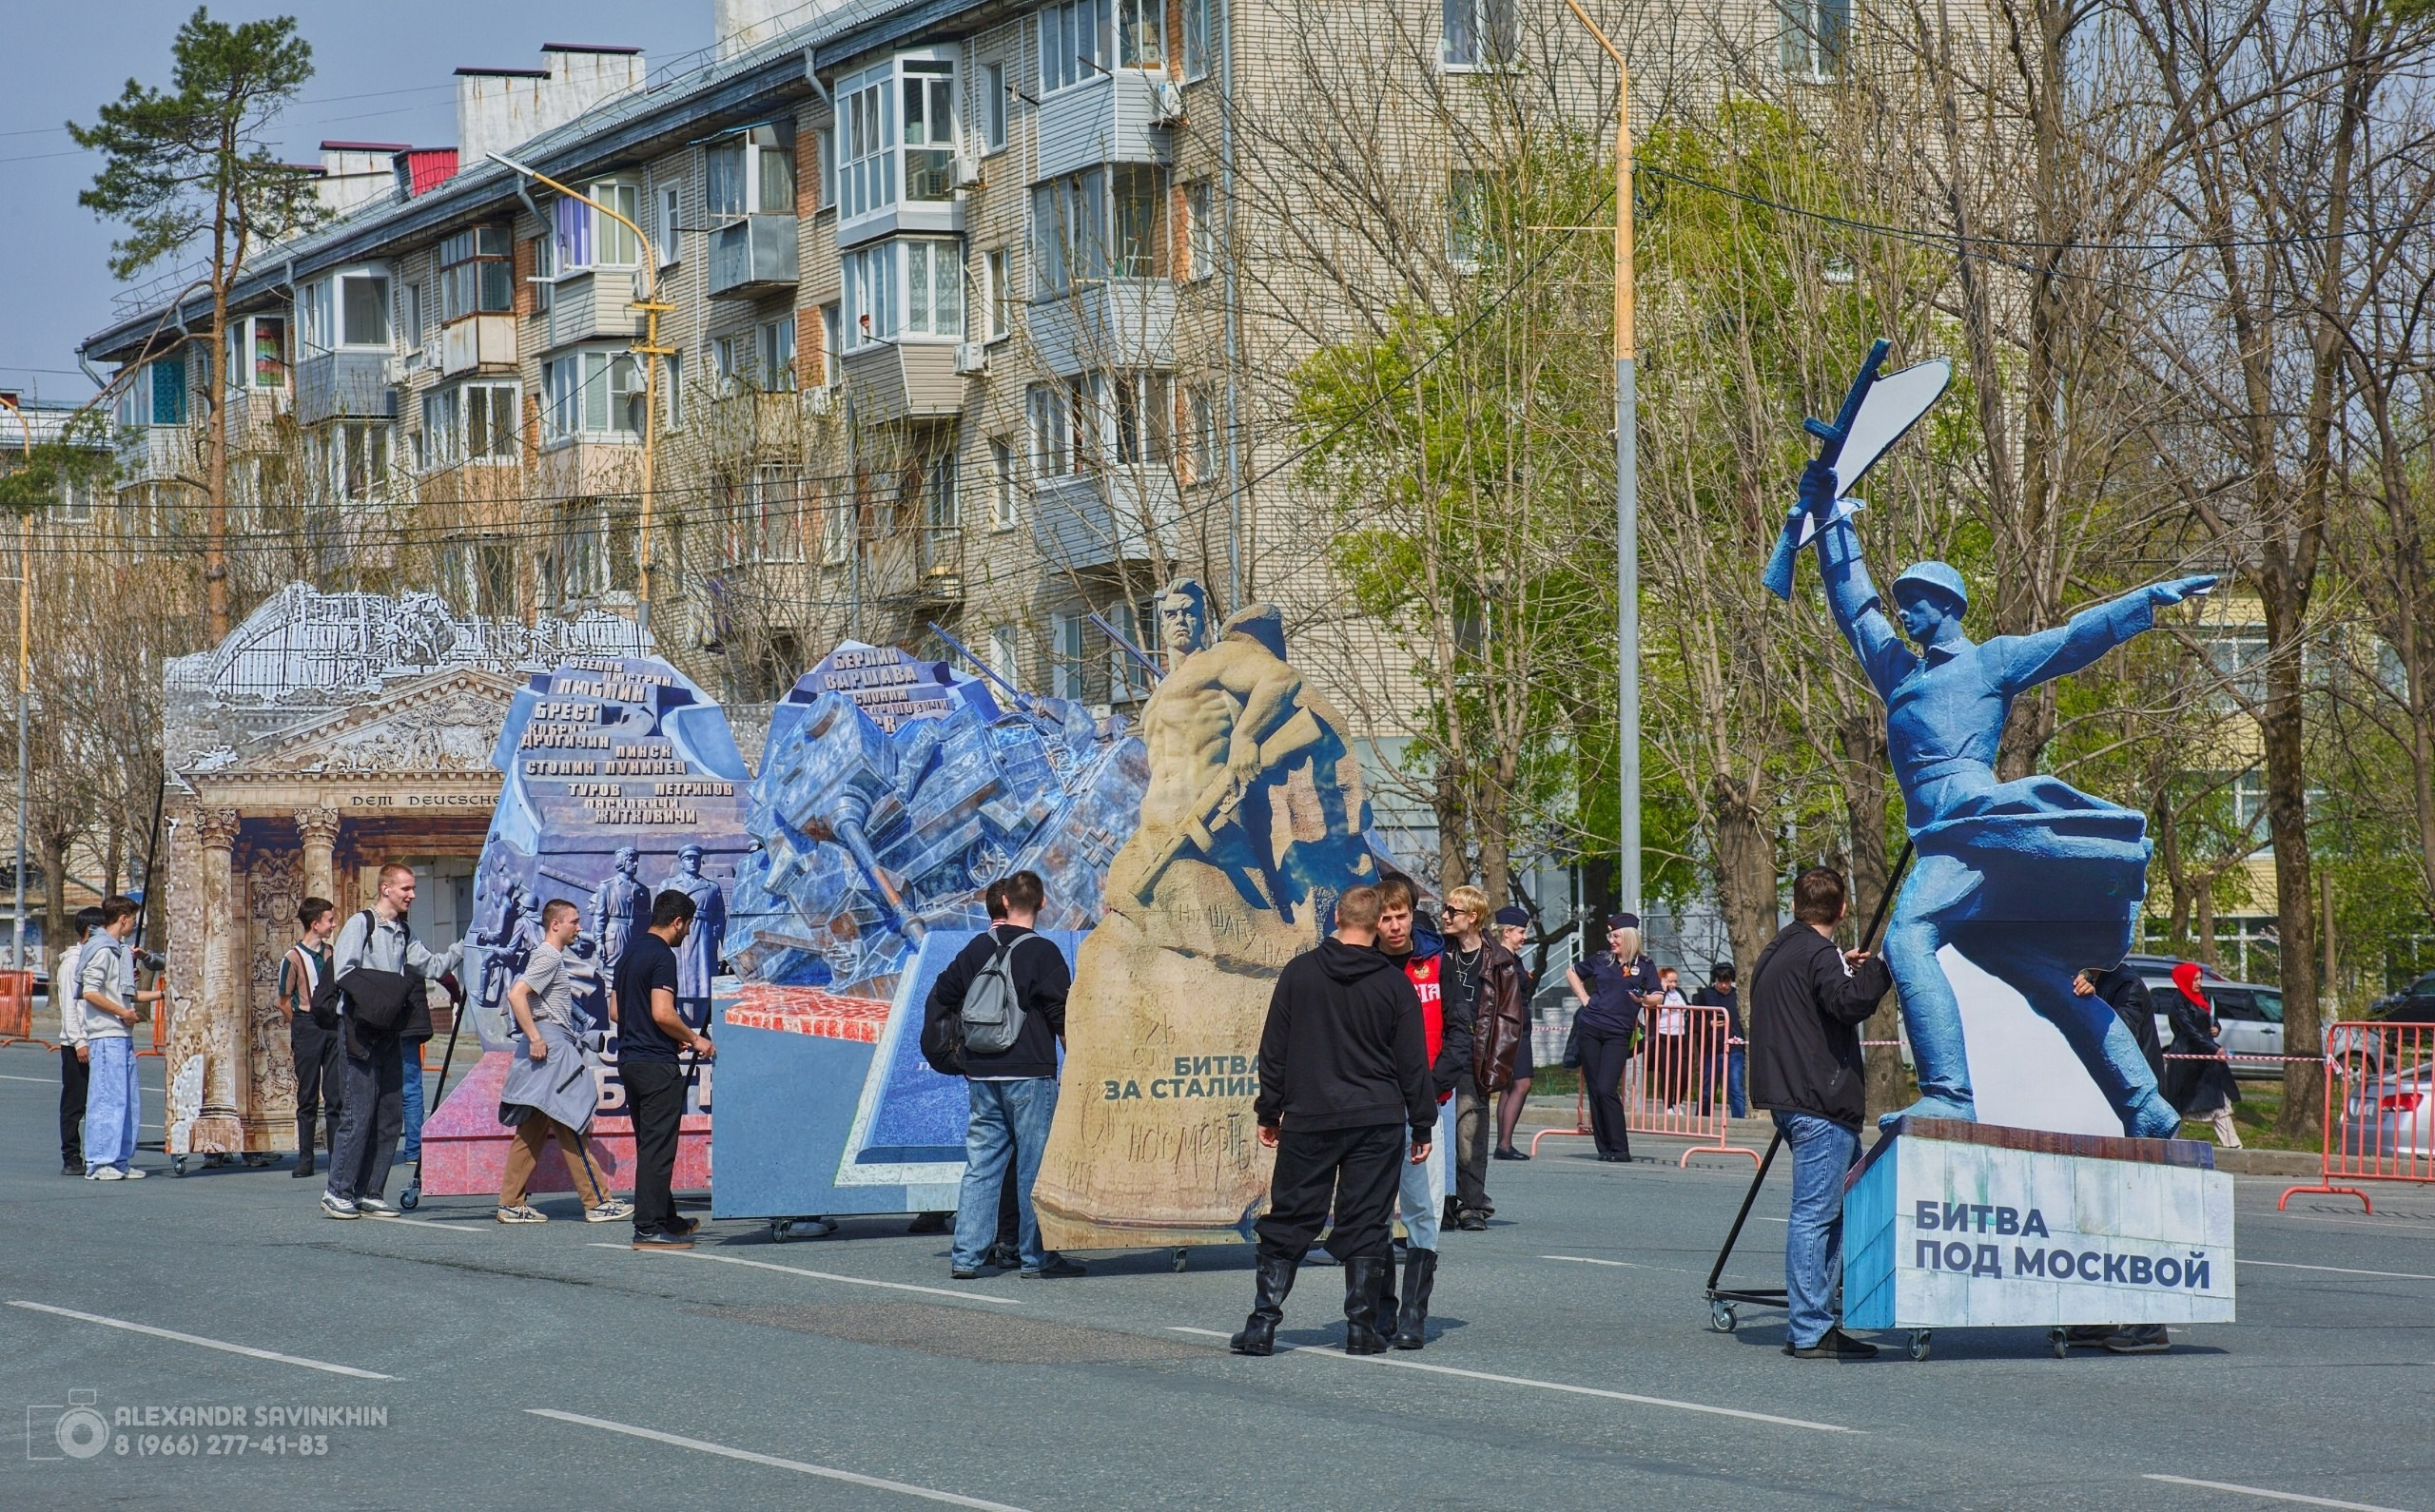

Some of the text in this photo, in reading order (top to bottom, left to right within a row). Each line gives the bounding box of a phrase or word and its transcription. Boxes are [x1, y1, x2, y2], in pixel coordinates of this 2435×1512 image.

[824, 666, 919, 690] ВАРШАВА
[557, 679, 647, 704] ЛЮБЛИН
[534, 701, 598, 722] БРЕСТ
[615, 745, 672, 759] ПИНСК
[351, 795, 394, 806] DEM
[568, 783, 621, 797] ТУРОВ
[1104, 1079, 1142, 1100] ЗА
[1916, 1200, 2050, 1238] БИТВА
[1916, 1240, 2210, 1289] ПОД МОСКВОЙ
